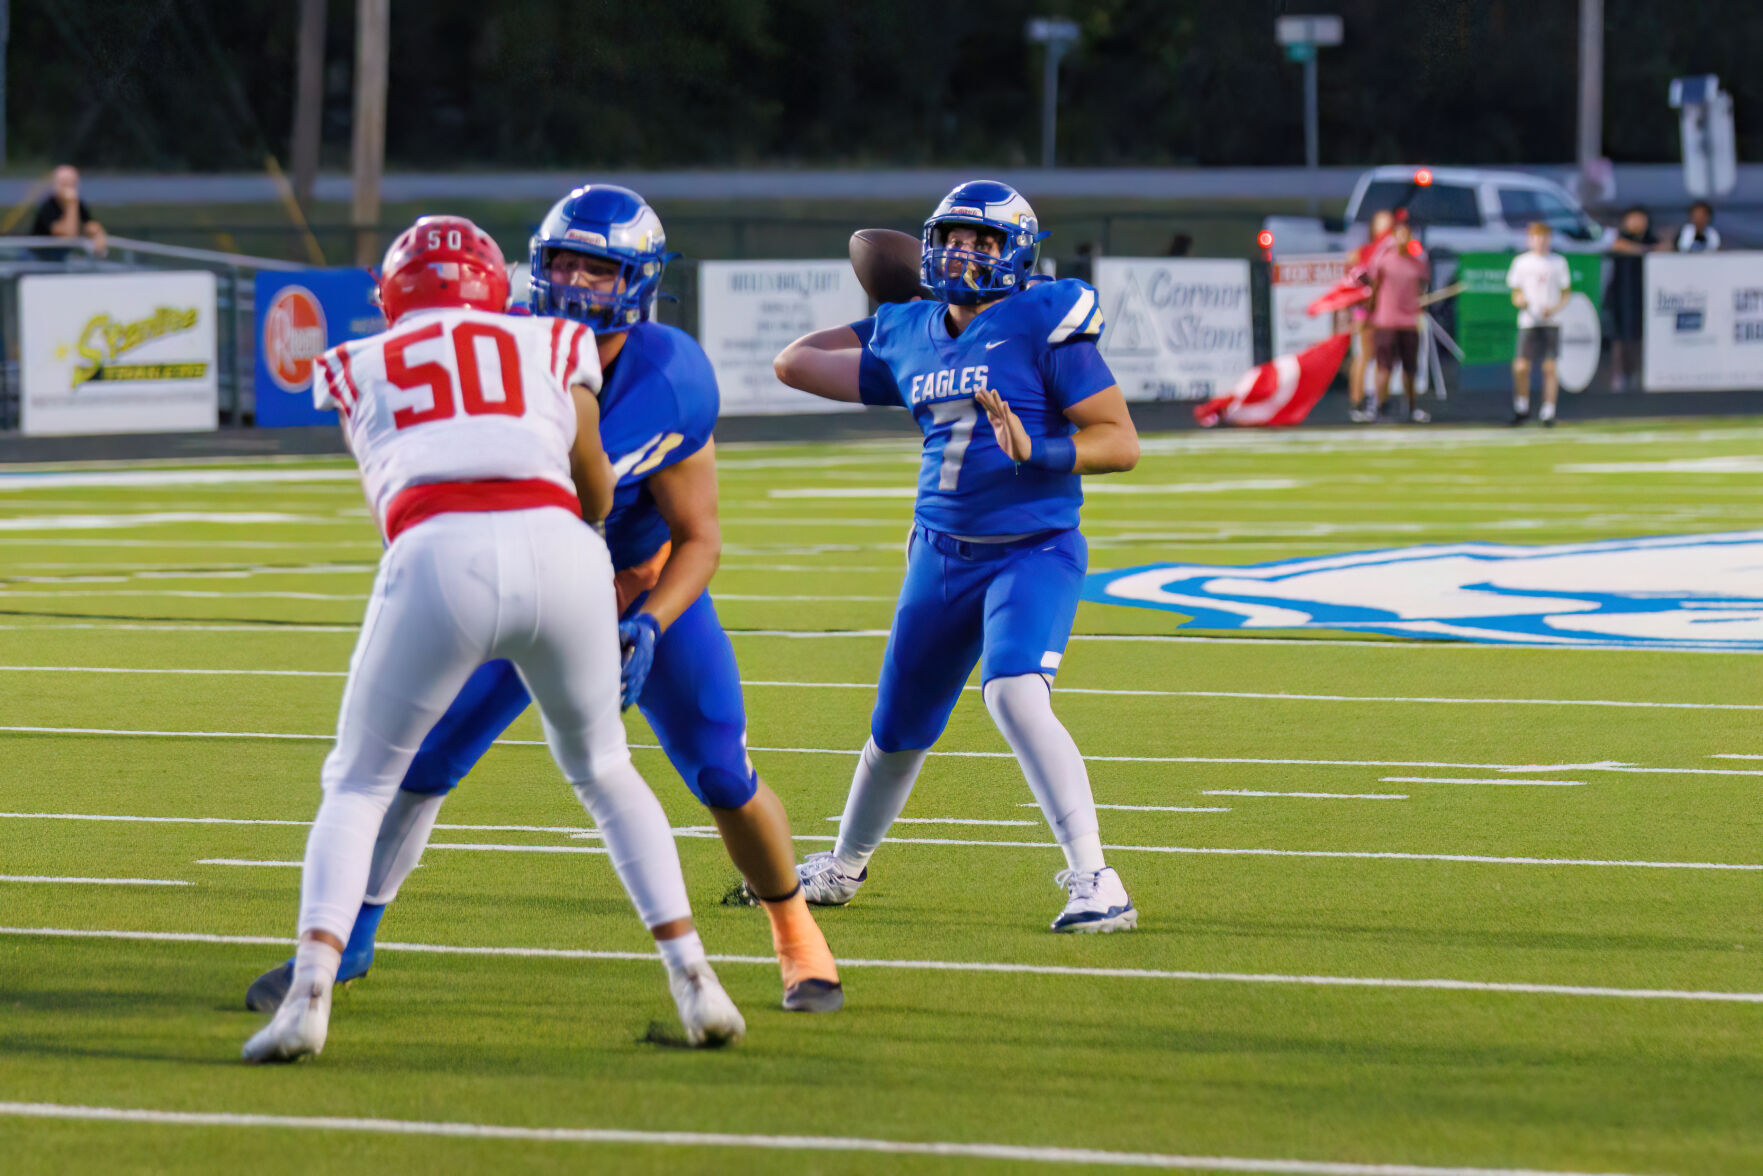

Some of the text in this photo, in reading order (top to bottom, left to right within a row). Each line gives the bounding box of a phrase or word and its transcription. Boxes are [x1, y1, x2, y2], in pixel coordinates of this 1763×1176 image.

[428, 230, 462, 250] 50
[383, 320, 526, 431] 50
[911, 364, 989, 405] EAGLES
[927, 398, 978, 491] 7
